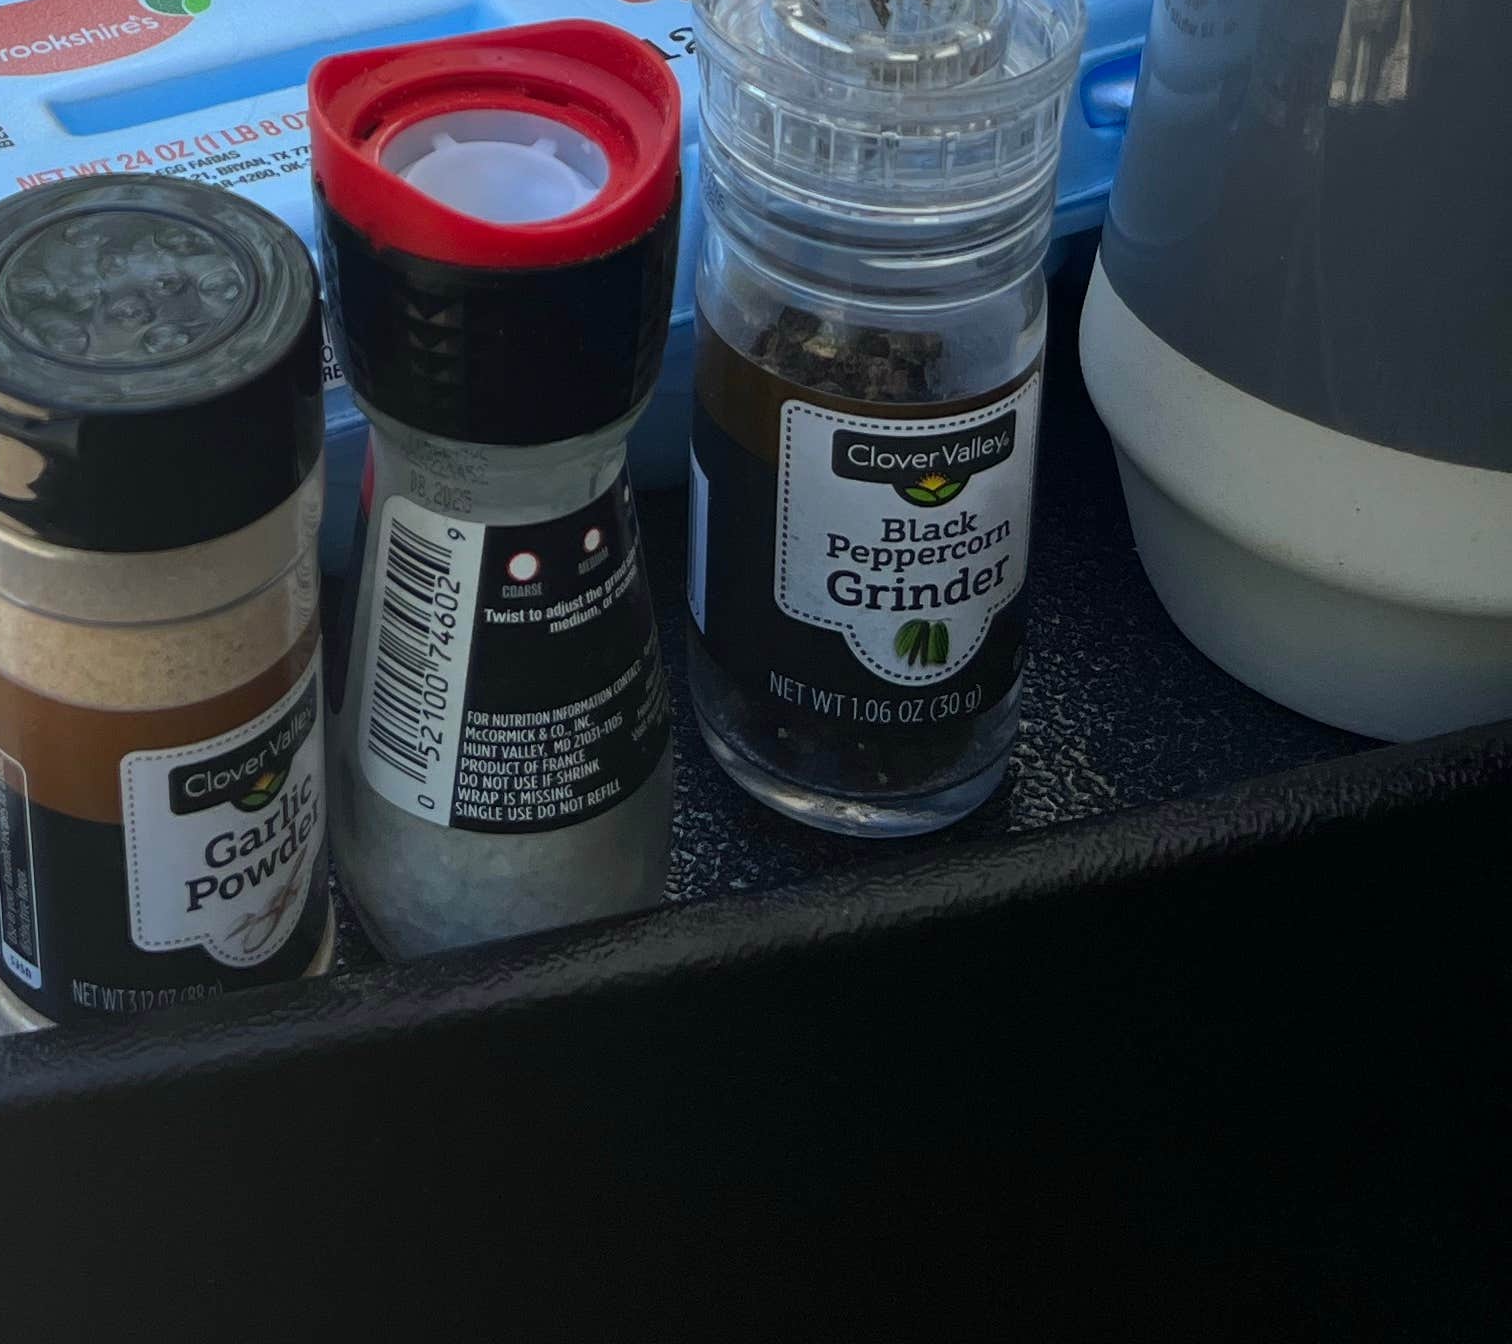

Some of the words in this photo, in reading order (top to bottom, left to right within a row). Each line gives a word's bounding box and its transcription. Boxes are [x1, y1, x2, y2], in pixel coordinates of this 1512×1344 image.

[16, 167, 65, 191] NET
[70, 160, 112, 178] WT
[117, 150, 153, 172] 24
[154, 140, 195, 161] OZ
[194, 133, 220, 156] (1
[221, 124, 259, 146] LB
[259, 120, 282, 136] 8
[188, 150, 241, 170] FARMS
[215, 157, 272, 177] BRYAN,
[269, 150, 292, 162] TX
[847, 444, 939, 470] Clover
[942, 431, 1007, 466] Valley
[826, 519, 1010, 573] Peppercorn
[881, 510, 978, 543] Black
[501, 582, 544, 599] COARSE
[826, 554, 1010, 612] Grinder
[428, 574, 461, 662] 74602
[484, 608, 525, 623] Twist
[529, 609, 543, 623] to
[546, 594, 585, 620] adjust
[587, 586, 604, 604] the
[549, 605, 603, 633] medium,
[602, 594, 614, 609] or
[467, 710, 488, 726] FOR
[492, 711, 551, 727] NUTRITION
[552, 686, 613, 724] INFORMATION
[769, 670, 806, 705] NET
[811, 686, 846, 717] WT
[851, 697, 891, 723] 1.06
[898, 699, 925, 723] OZ
[930, 691, 960, 722] (30
[964, 683, 983, 712] g)
[416, 673, 449, 762] 52100
[465, 726, 536, 743] McCORMICK
[539, 729, 548, 740] &
[574, 715, 595, 732] INC.
[185, 749, 268, 798] Clover
[269, 707, 313, 757] Valley
[461, 757, 520, 775] PRODUCT
[524, 761, 539, 774] OF
[542, 749, 586, 772] FRANCE
[463, 742, 497, 758] HUNT
[501, 743, 548, 760] VALLEY,
[554, 739, 571, 754] MD
[459, 772, 478, 787] DO
[482, 775, 509, 790] NOT
[514, 775, 538, 790] USE
[542, 773, 553, 787] IF
[556, 758, 601, 785] SHRINK
[417, 794, 436, 810] 0
[454, 801, 503, 821] SINGLE
[508, 807, 533, 821] USE
[537, 804, 556, 819] DO
[559, 797, 583, 815] NOT
[587, 778, 622, 806] REFILL
[457, 786, 499, 805] WRAP
[504, 792, 516, 806] IS
[520, 784, 573, 806] MISSING
[205, 773, 313, 869] Garlic
[184, 794, 319, 913] Powder
[72, 978, 99, 1009] NET
[102, 986, 126, 1012] WT
